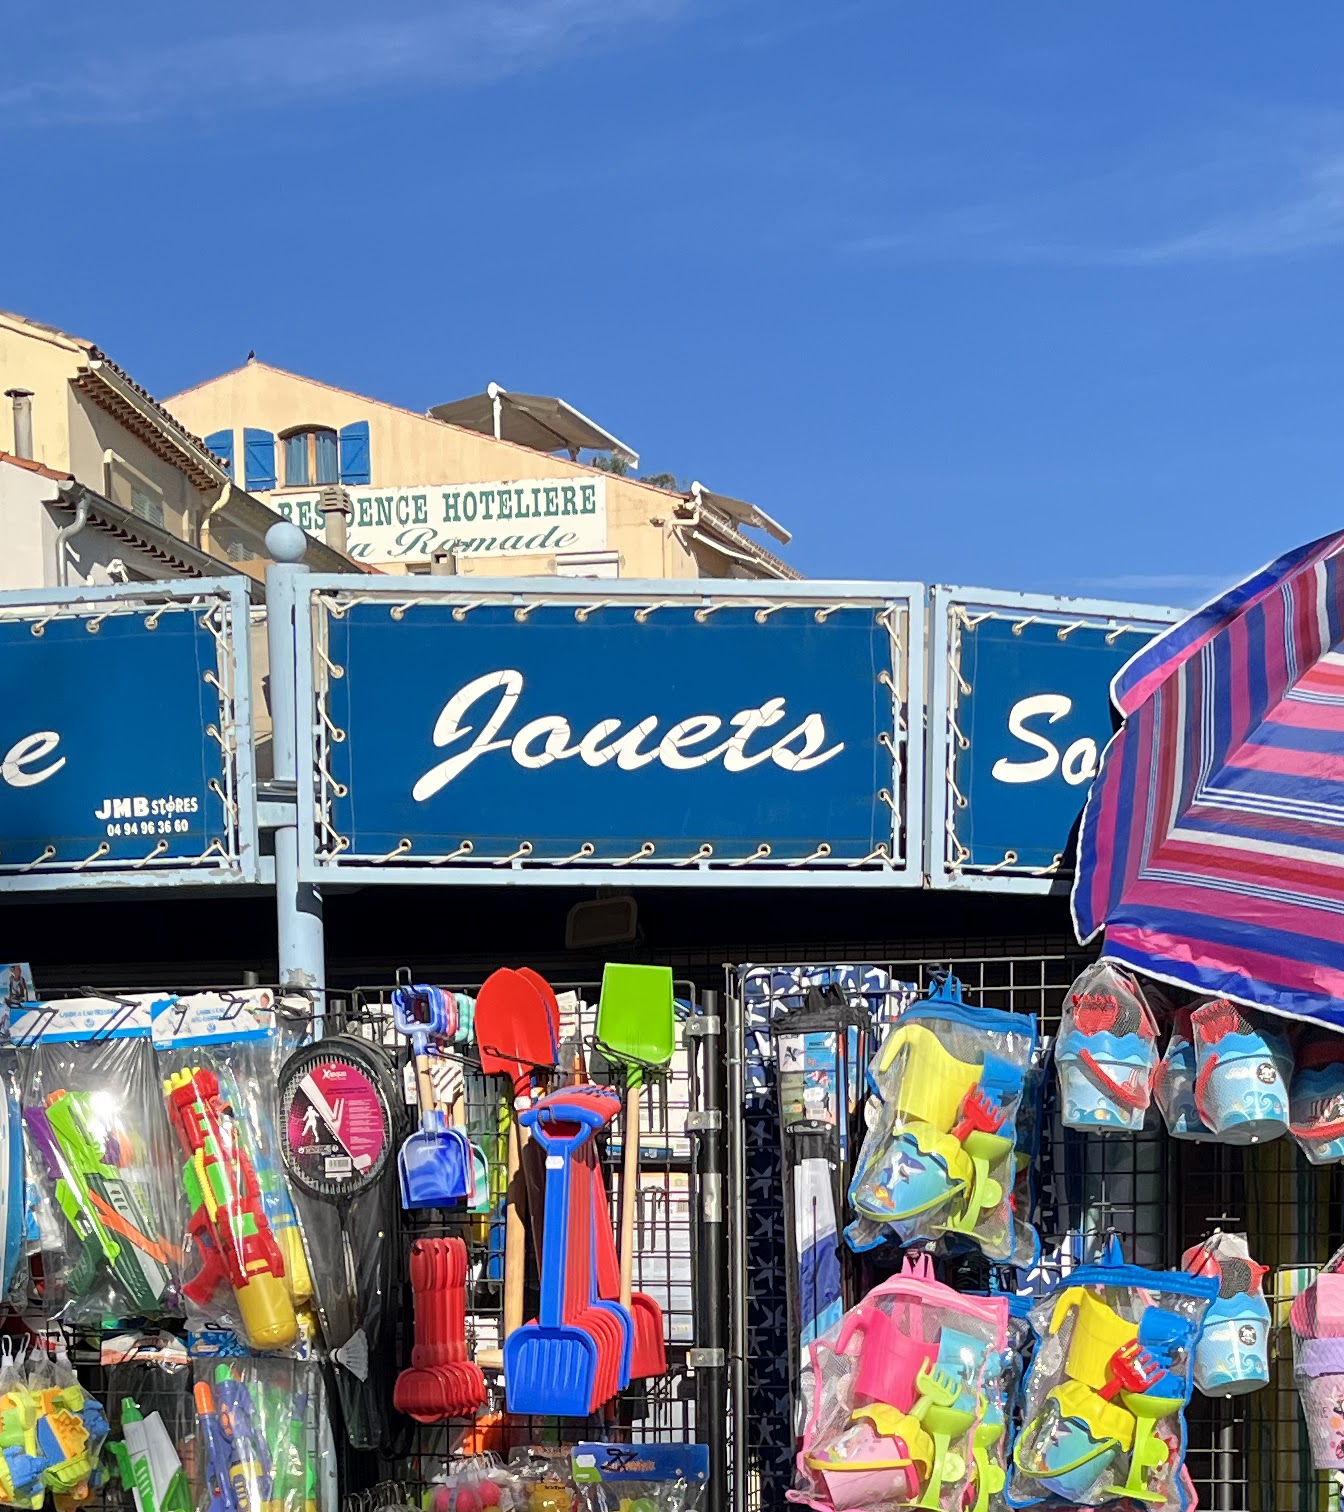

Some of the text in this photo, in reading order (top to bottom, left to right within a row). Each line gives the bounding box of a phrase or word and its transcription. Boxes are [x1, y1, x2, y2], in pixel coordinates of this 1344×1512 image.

[278, 484, 597, 530] RESDENCE HOTELIERE
[412, 669, 845, 802] Jouets
[94, 796, 150, 820] JMB
[106, 818, 189, 837] 04 94 96 36 60
